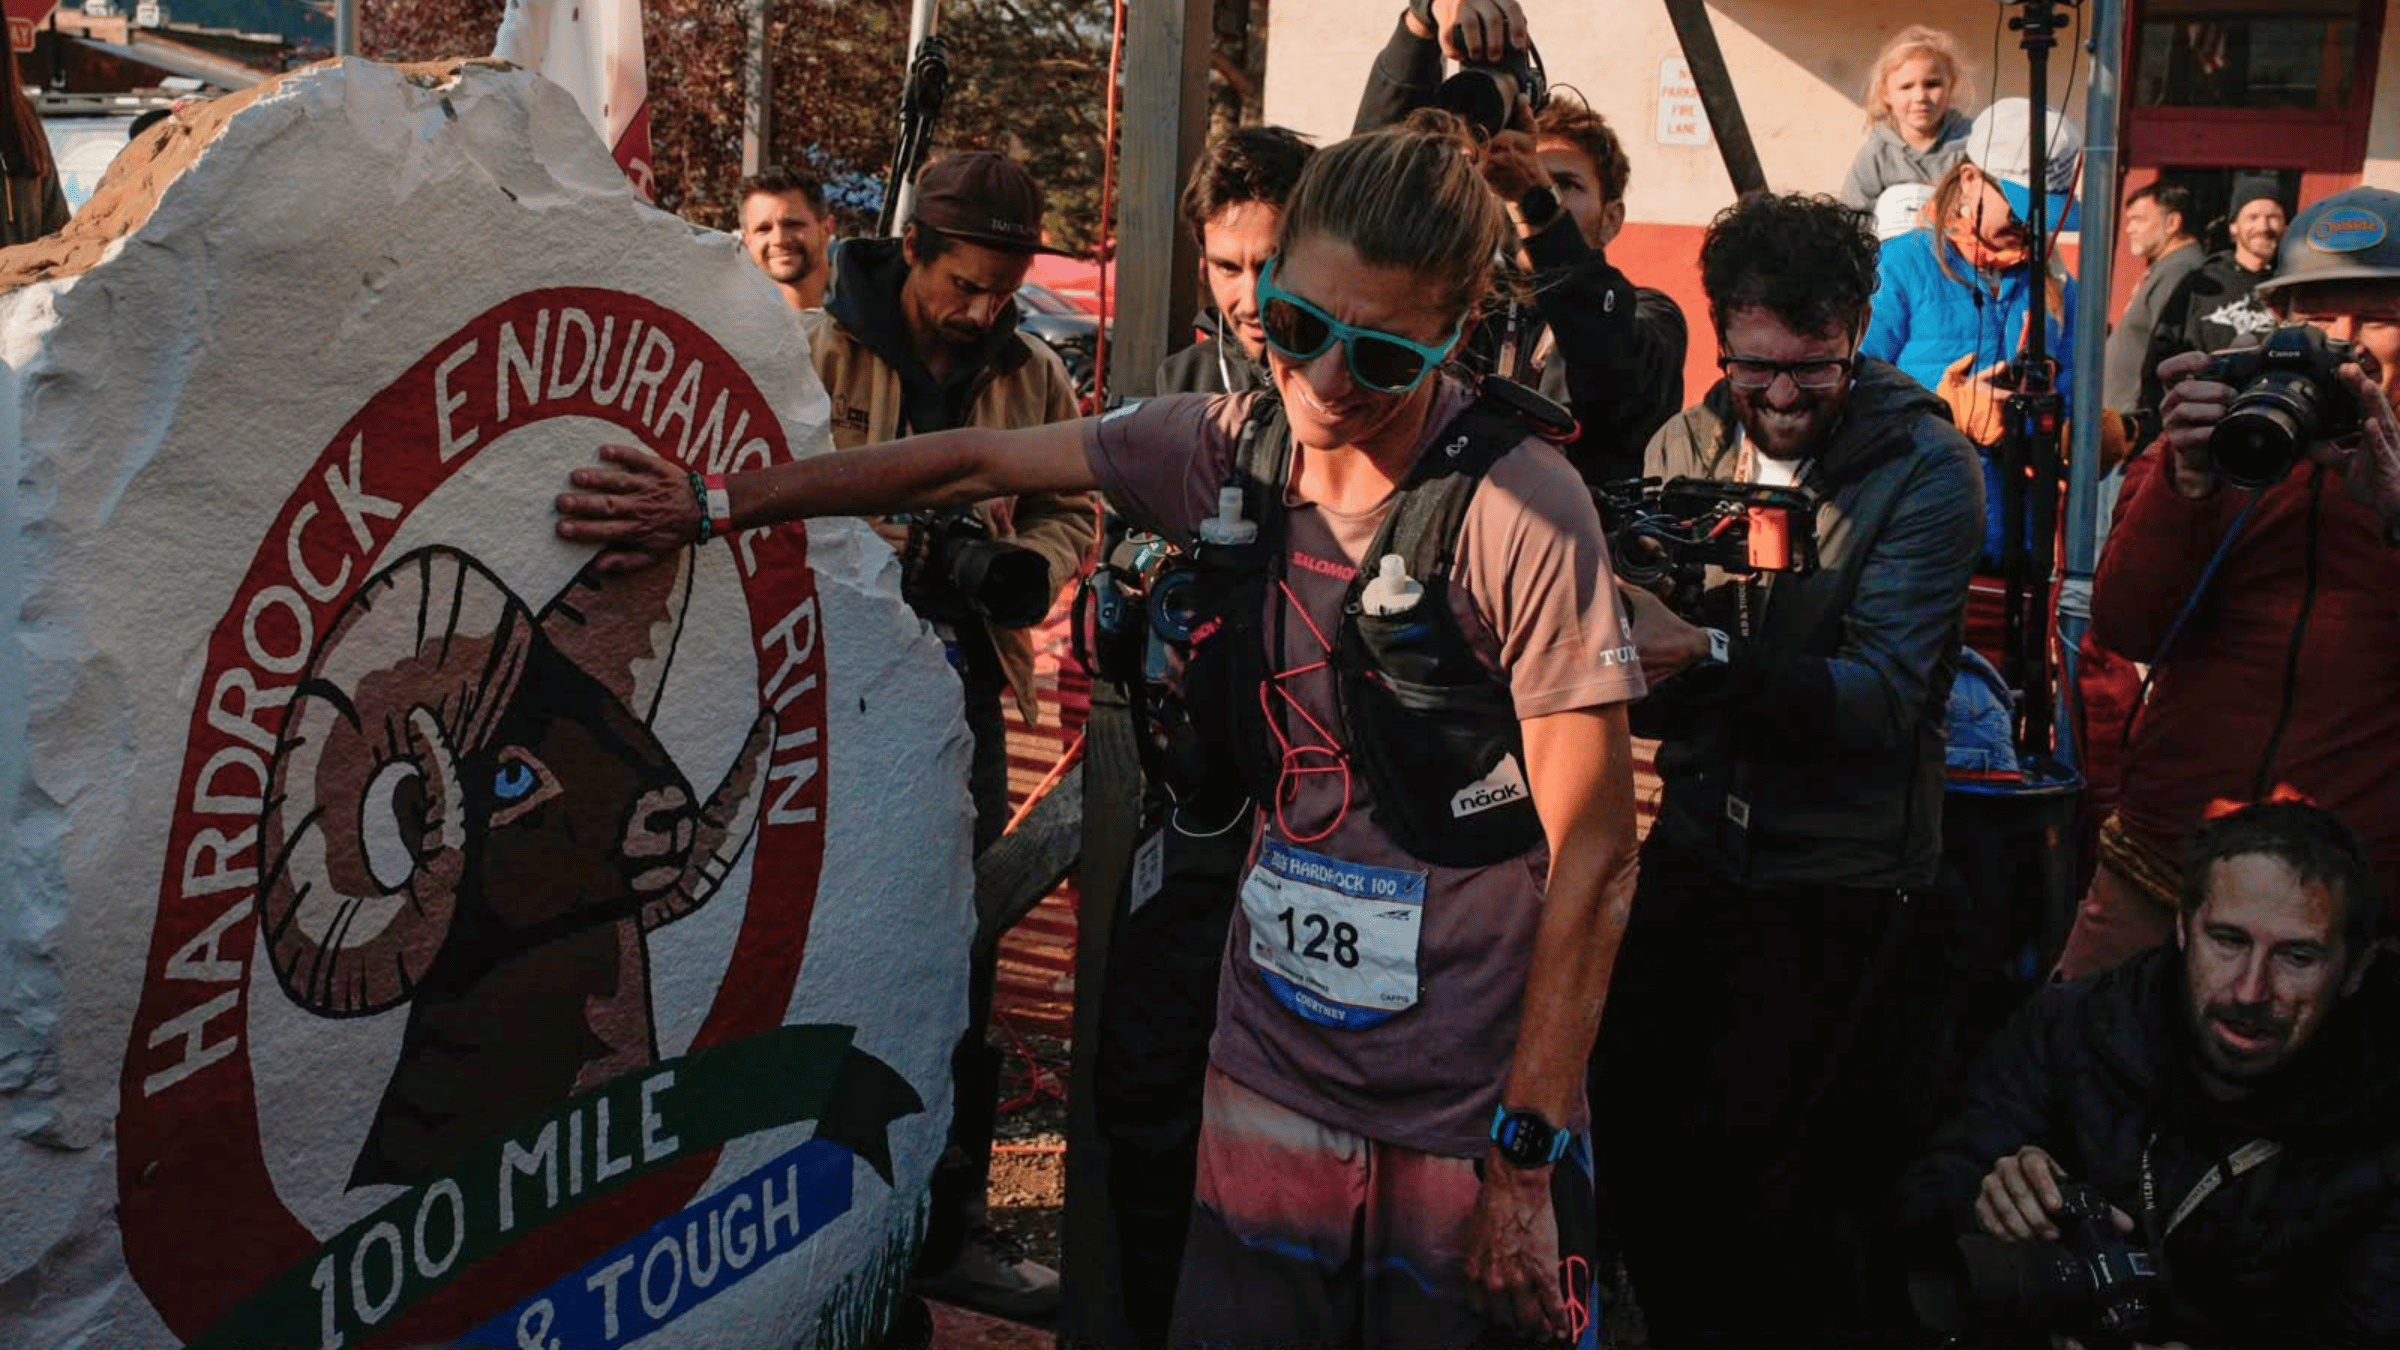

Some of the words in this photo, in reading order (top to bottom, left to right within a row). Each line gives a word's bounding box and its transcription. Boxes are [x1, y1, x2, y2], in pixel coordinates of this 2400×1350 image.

[2268, 350, 2300, 358] Canon
[1293, 548, 1358, 580] SALOMO
[144, 430, 403, 1098] HARDROCK
[761, 596, 819, 826] RUN
[1460, 783, 1521, 811] näak
[1371, 876, 1397, 896] 100
[1277, 906, 1360, 969] 128
[1295, 992, 1347, 1021] COURTNEY
[311, 1178, 465, 1350] 100
[499, 1069, 680, 1233] MILE
[586, 1163, 800, 1341] TOUGH
